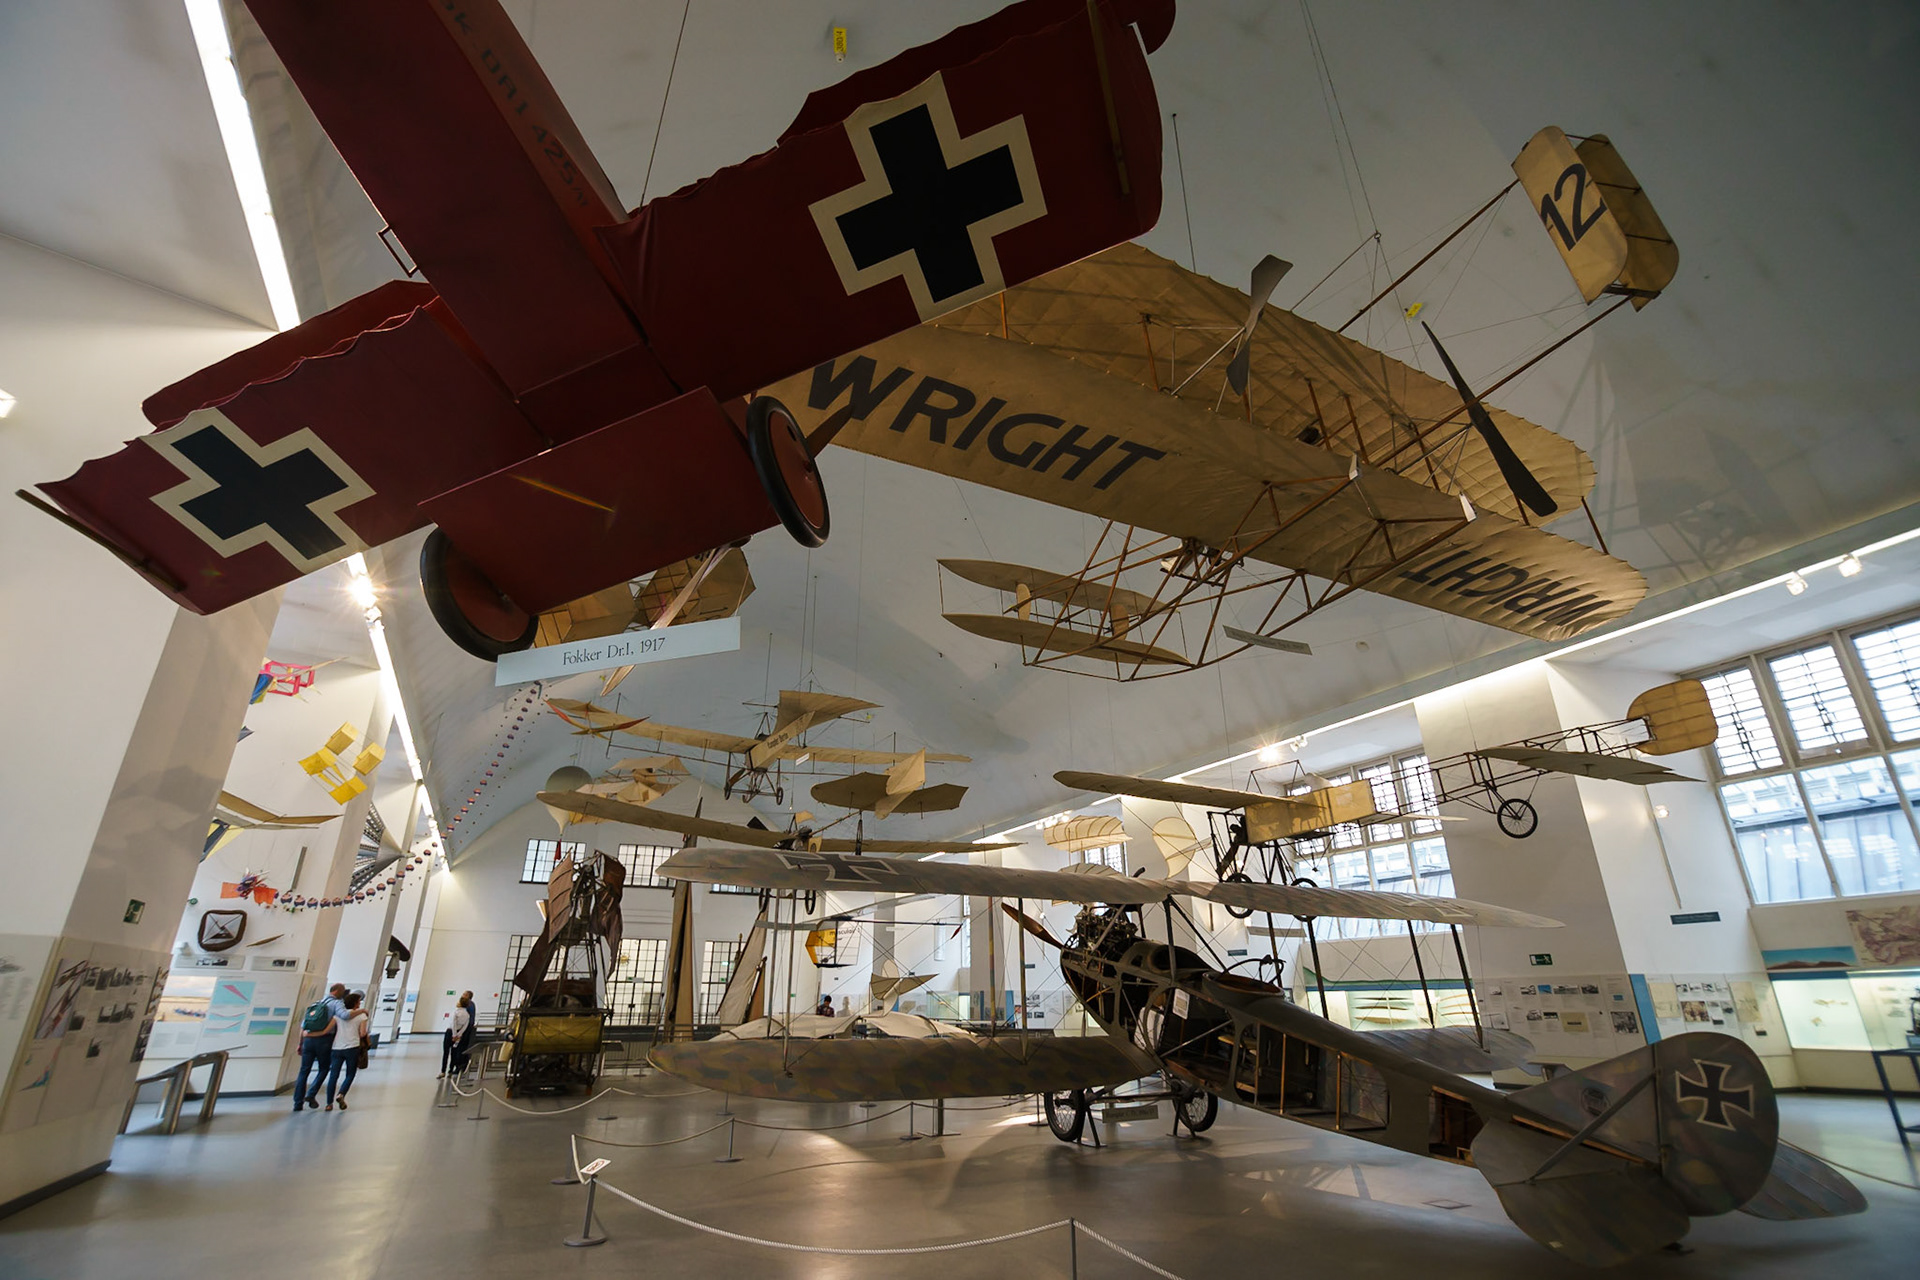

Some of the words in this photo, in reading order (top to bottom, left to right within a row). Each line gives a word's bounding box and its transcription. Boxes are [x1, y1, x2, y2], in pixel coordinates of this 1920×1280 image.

[1540, 162, 1608, 251] 12
[807, 355, 1167, 491] WRIGHT
[1398, 550, 1614, 626] WRIGHT
[562, 648, 602, 665] Fokker
[640, 637, 666, 654] 1917
